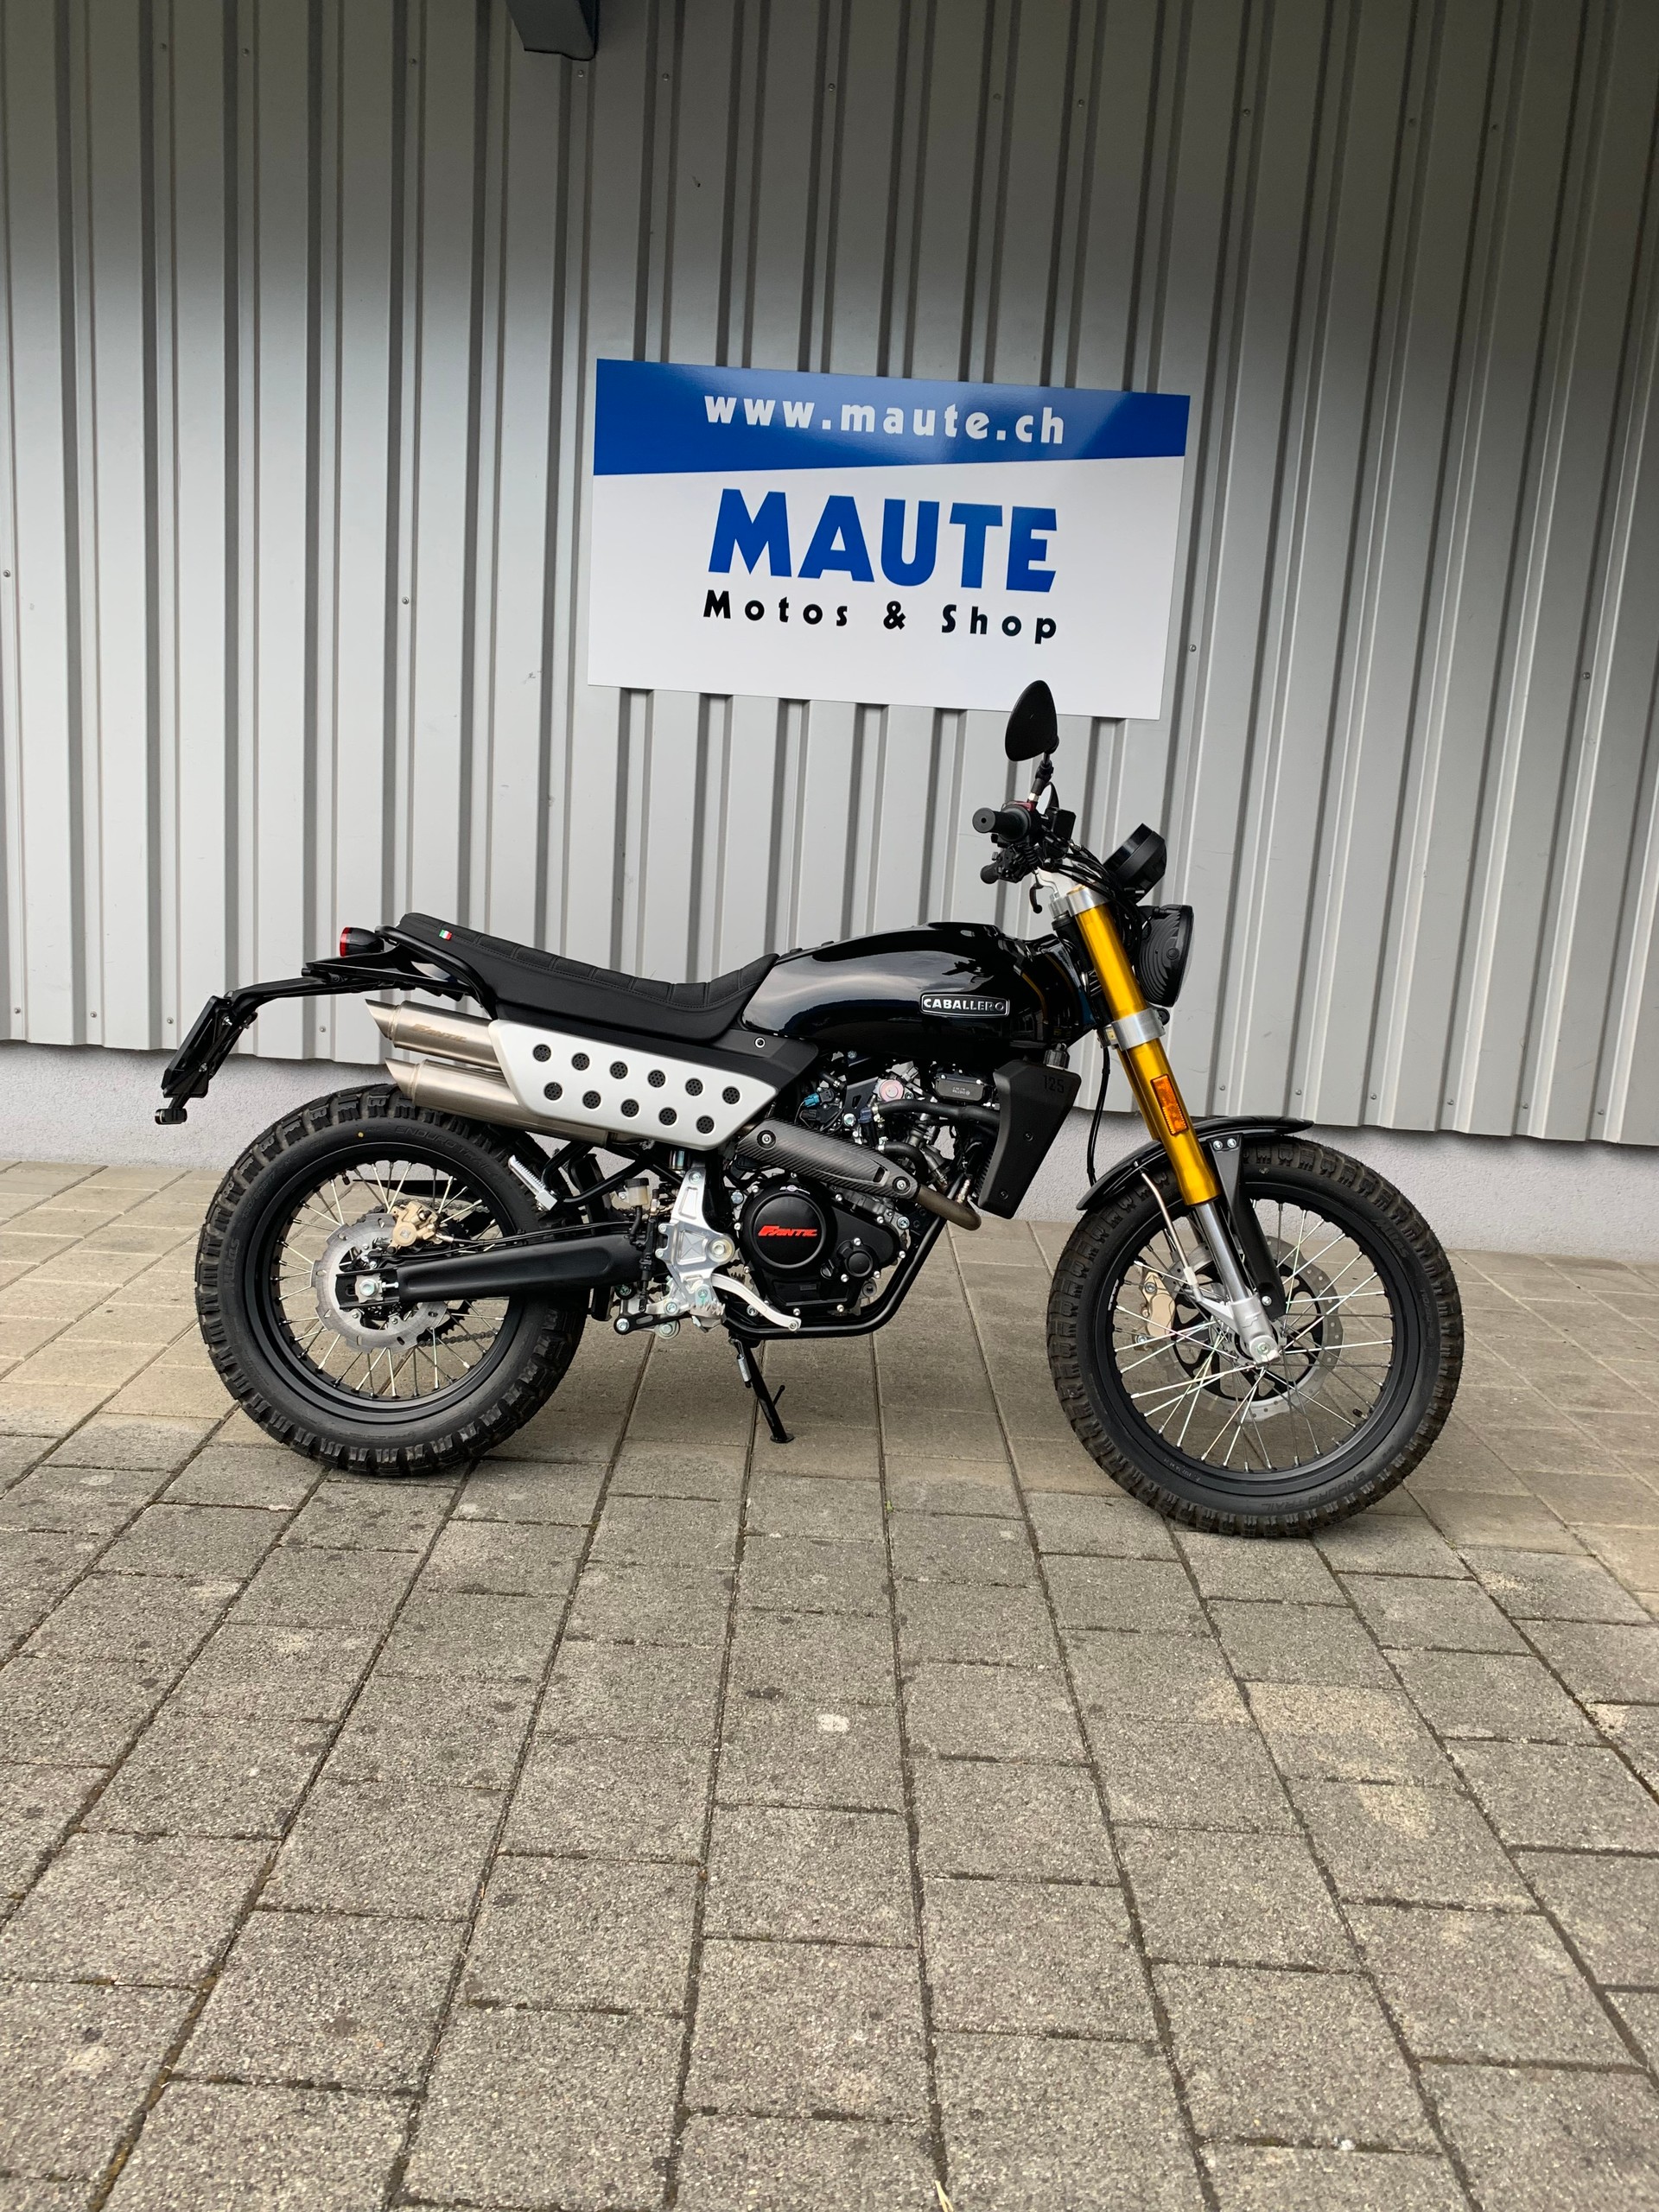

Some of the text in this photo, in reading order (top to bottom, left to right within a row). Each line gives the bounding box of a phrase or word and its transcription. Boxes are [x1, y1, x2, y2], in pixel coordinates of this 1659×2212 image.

[704, 395, 1065, 444] www.maute.ch
[708, 488, 1058, 593] MAUTE
[702, 589, 1057, 645] Motos & Shop
[923, 998, 1004, 1012] CABALLERO
[1042, 1074, 1065, 1094] 125
[394, 1125, 456, 1149] ENDURO
[757, 1224, 818, 1237] FANTIC
